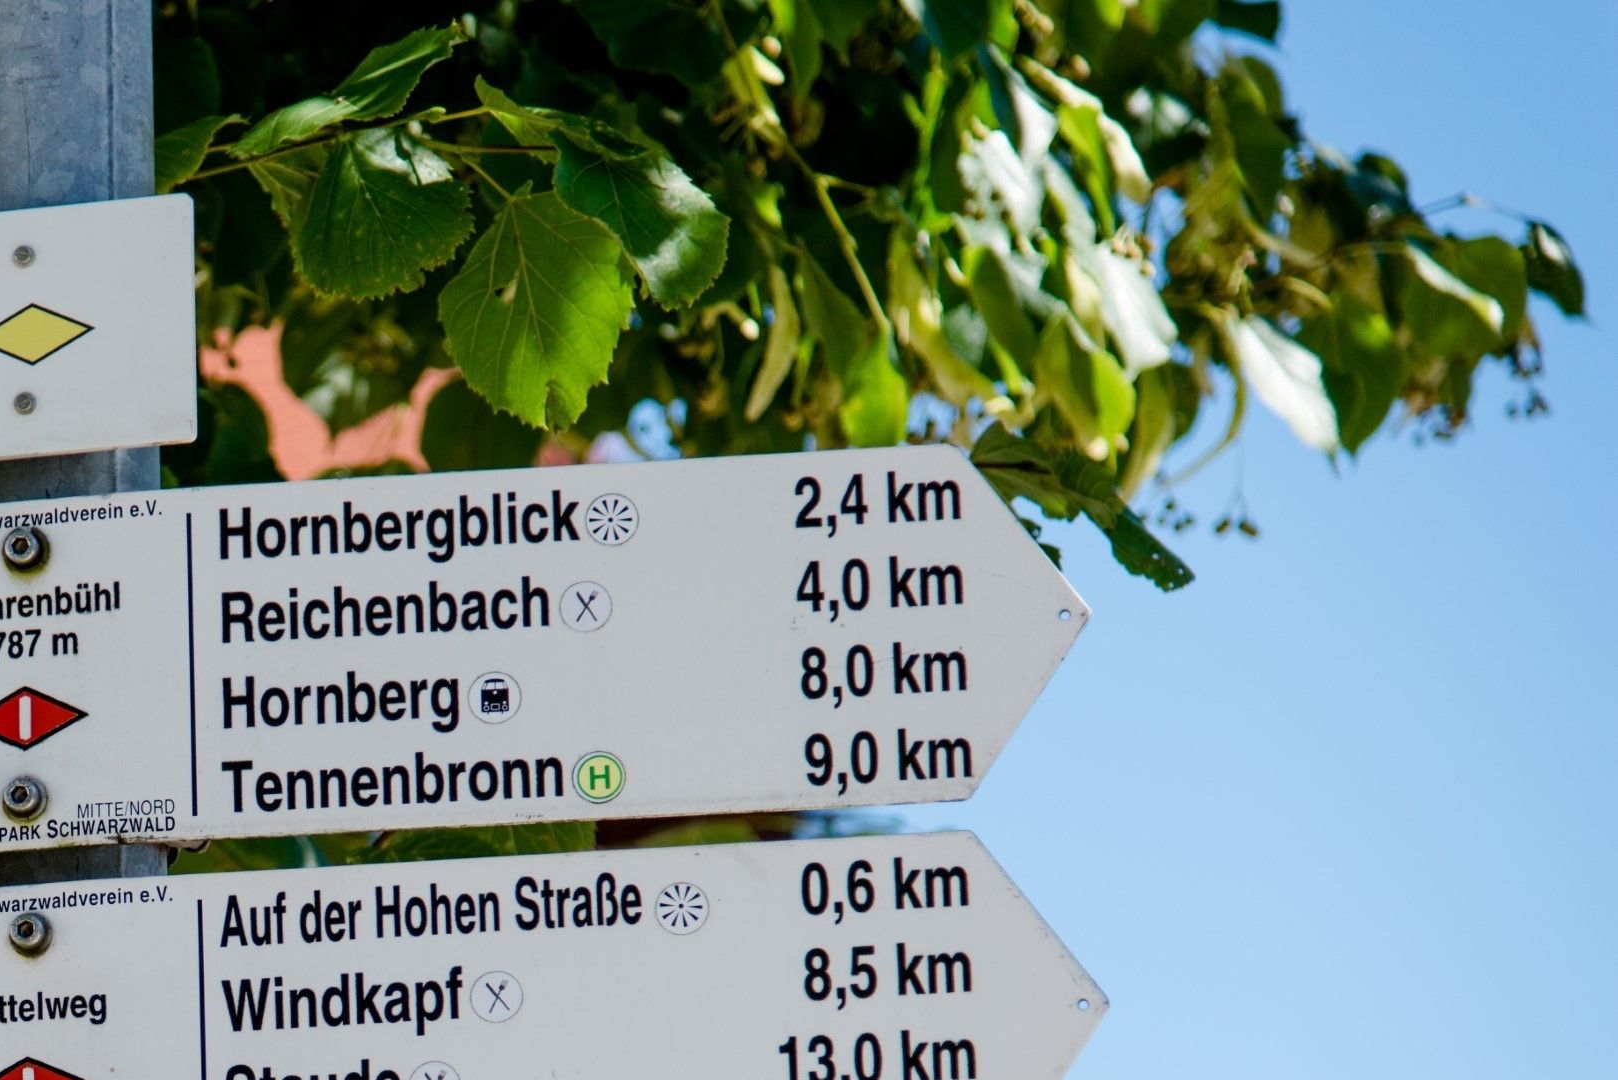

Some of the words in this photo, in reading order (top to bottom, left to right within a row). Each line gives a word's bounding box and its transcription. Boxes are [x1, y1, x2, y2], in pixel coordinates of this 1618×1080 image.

[130, 500, 162, 516] e.V.
[220, 490, 579, 563] Hornbergblick
[795, 474, 868, 538] 2,4
[887, 471, 961, 523] km
[222, 576, 549, 643] Reichenbach
[796, 558, 869, 623] 4,0
[889, 556, 963, 608] km
[52, 633, 78, 655] m
[801, 644, 874, 709] 8,0
[893, 642, 967, 694] km
[223, 671, 459, 733] Hornberg
[222, 752, 563, 812] Tennenbronn
[805, 731, 878, 796] 9,0
[898, 728, 972, 780] km
[47, 815, 175, 840] SCHWARZWALD
[78, 799, 175, 821] MITTE/NORD
[140, 886, 173, 902] e.V.
[221, 892, 286, 947] Auf
[300, 889, 361, 943] der
[375, 883, 500, 939] Hohen
[515, 872, 641, 931] Straße
[801, 860, 875, 925] 0,6
[894, 857, 969, 910] km
[222, 966, 462, 1036] Windkapf
[804, 946, 877, 1010] 8,5
[897, 943, 972, 995] km
